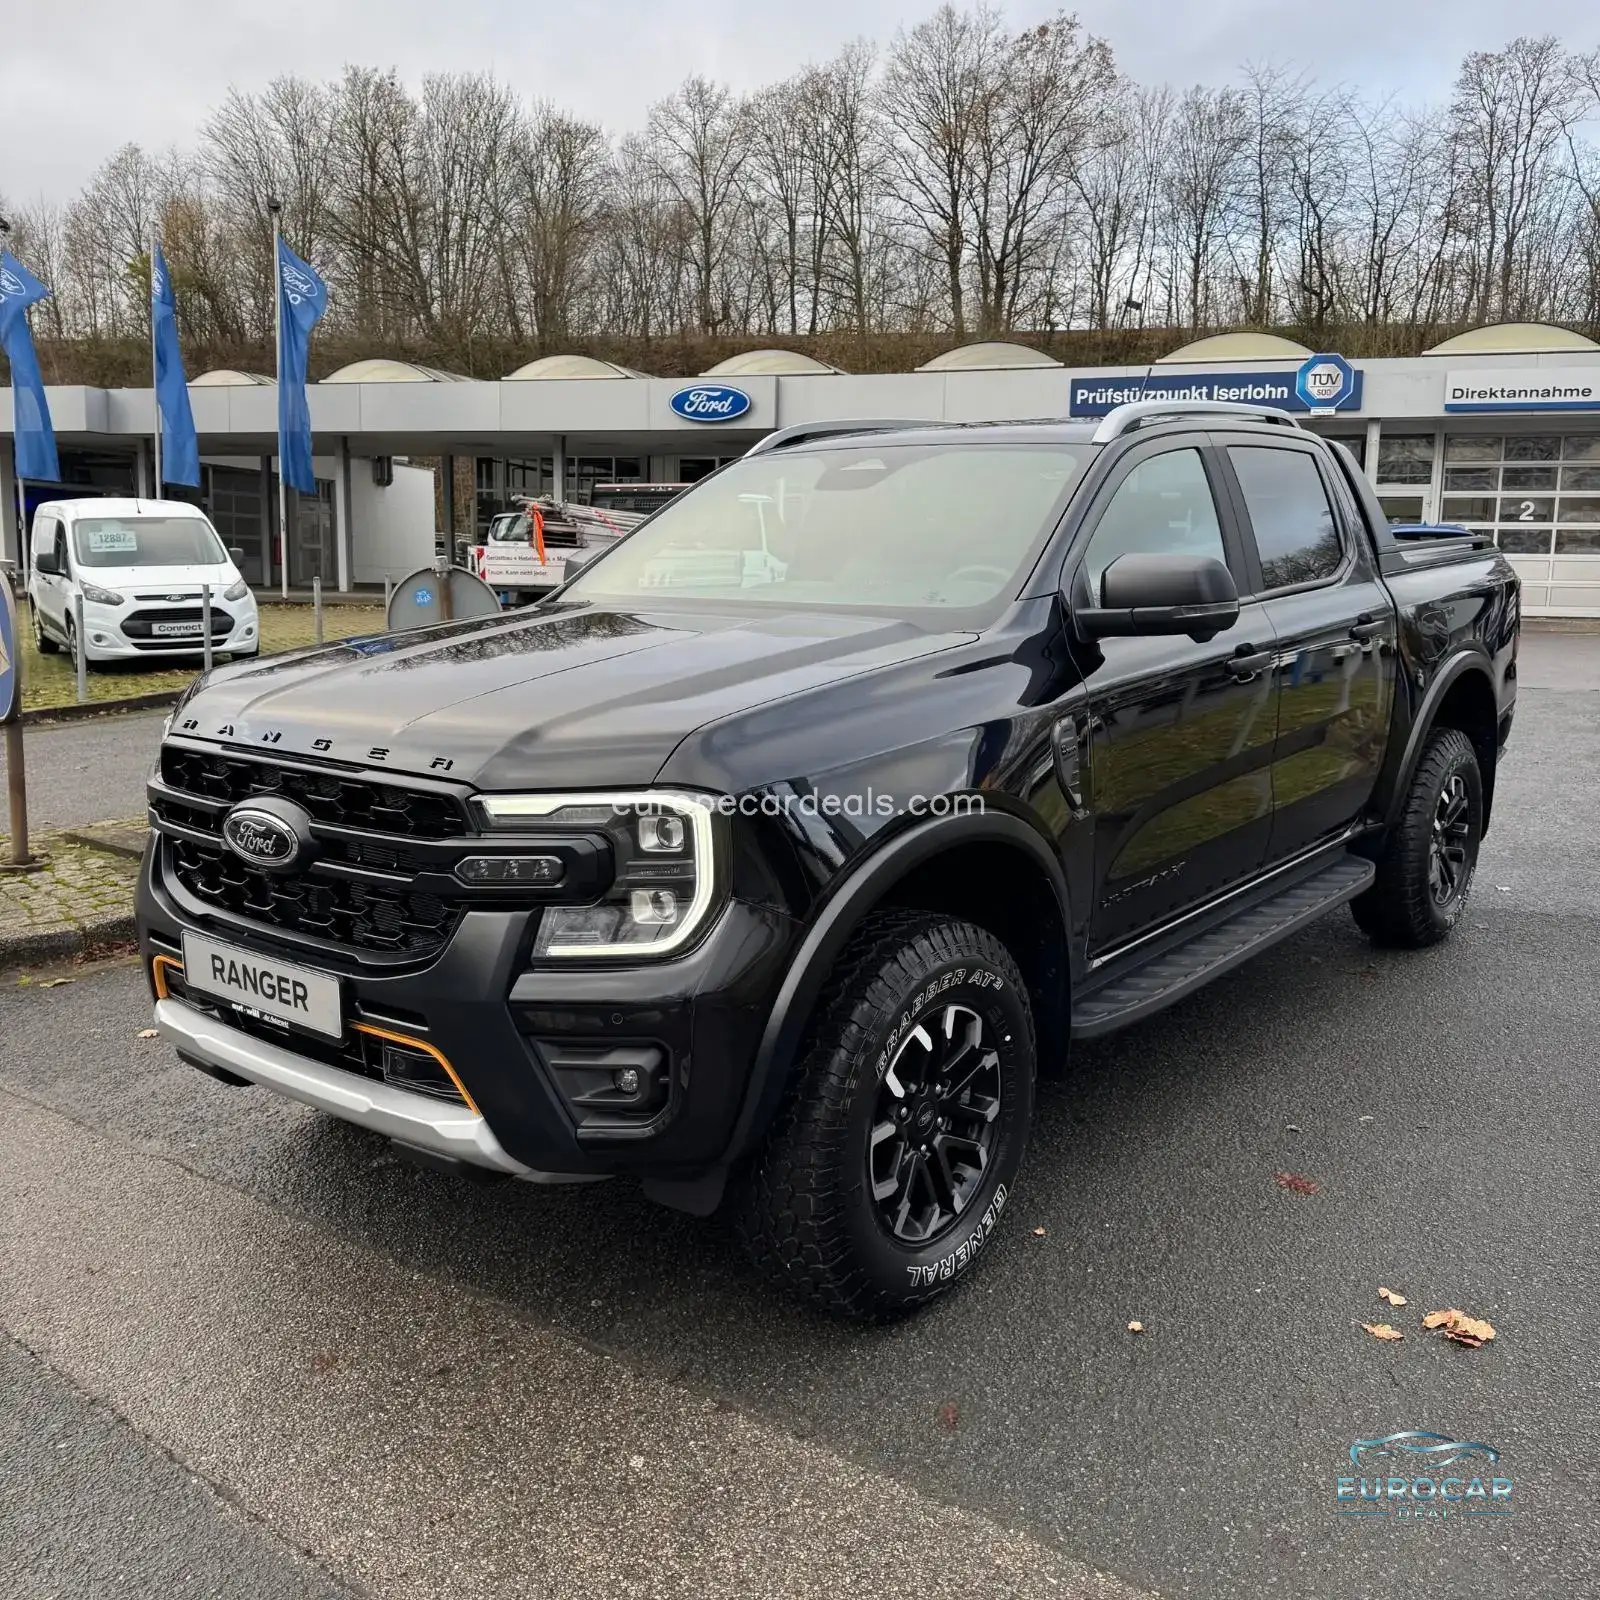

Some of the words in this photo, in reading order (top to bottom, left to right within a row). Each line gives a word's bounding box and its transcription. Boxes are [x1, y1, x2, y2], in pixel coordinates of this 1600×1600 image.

[1310, 373, 1340, 386] TÜV
[684, 390, 734, 413] Ford
[1213, 383, 1289, 401] Iserlohn
[1452, 386, 1593, 400] Direktannahme
[1519, 501, 1535, 521] 2
[158, 624, 202, 632] Connect
[236, 820, 277, 855] Ford
[211, 954, 309, 1012] RANGER
[907, 1183, 1008, 1287] GENERAL
